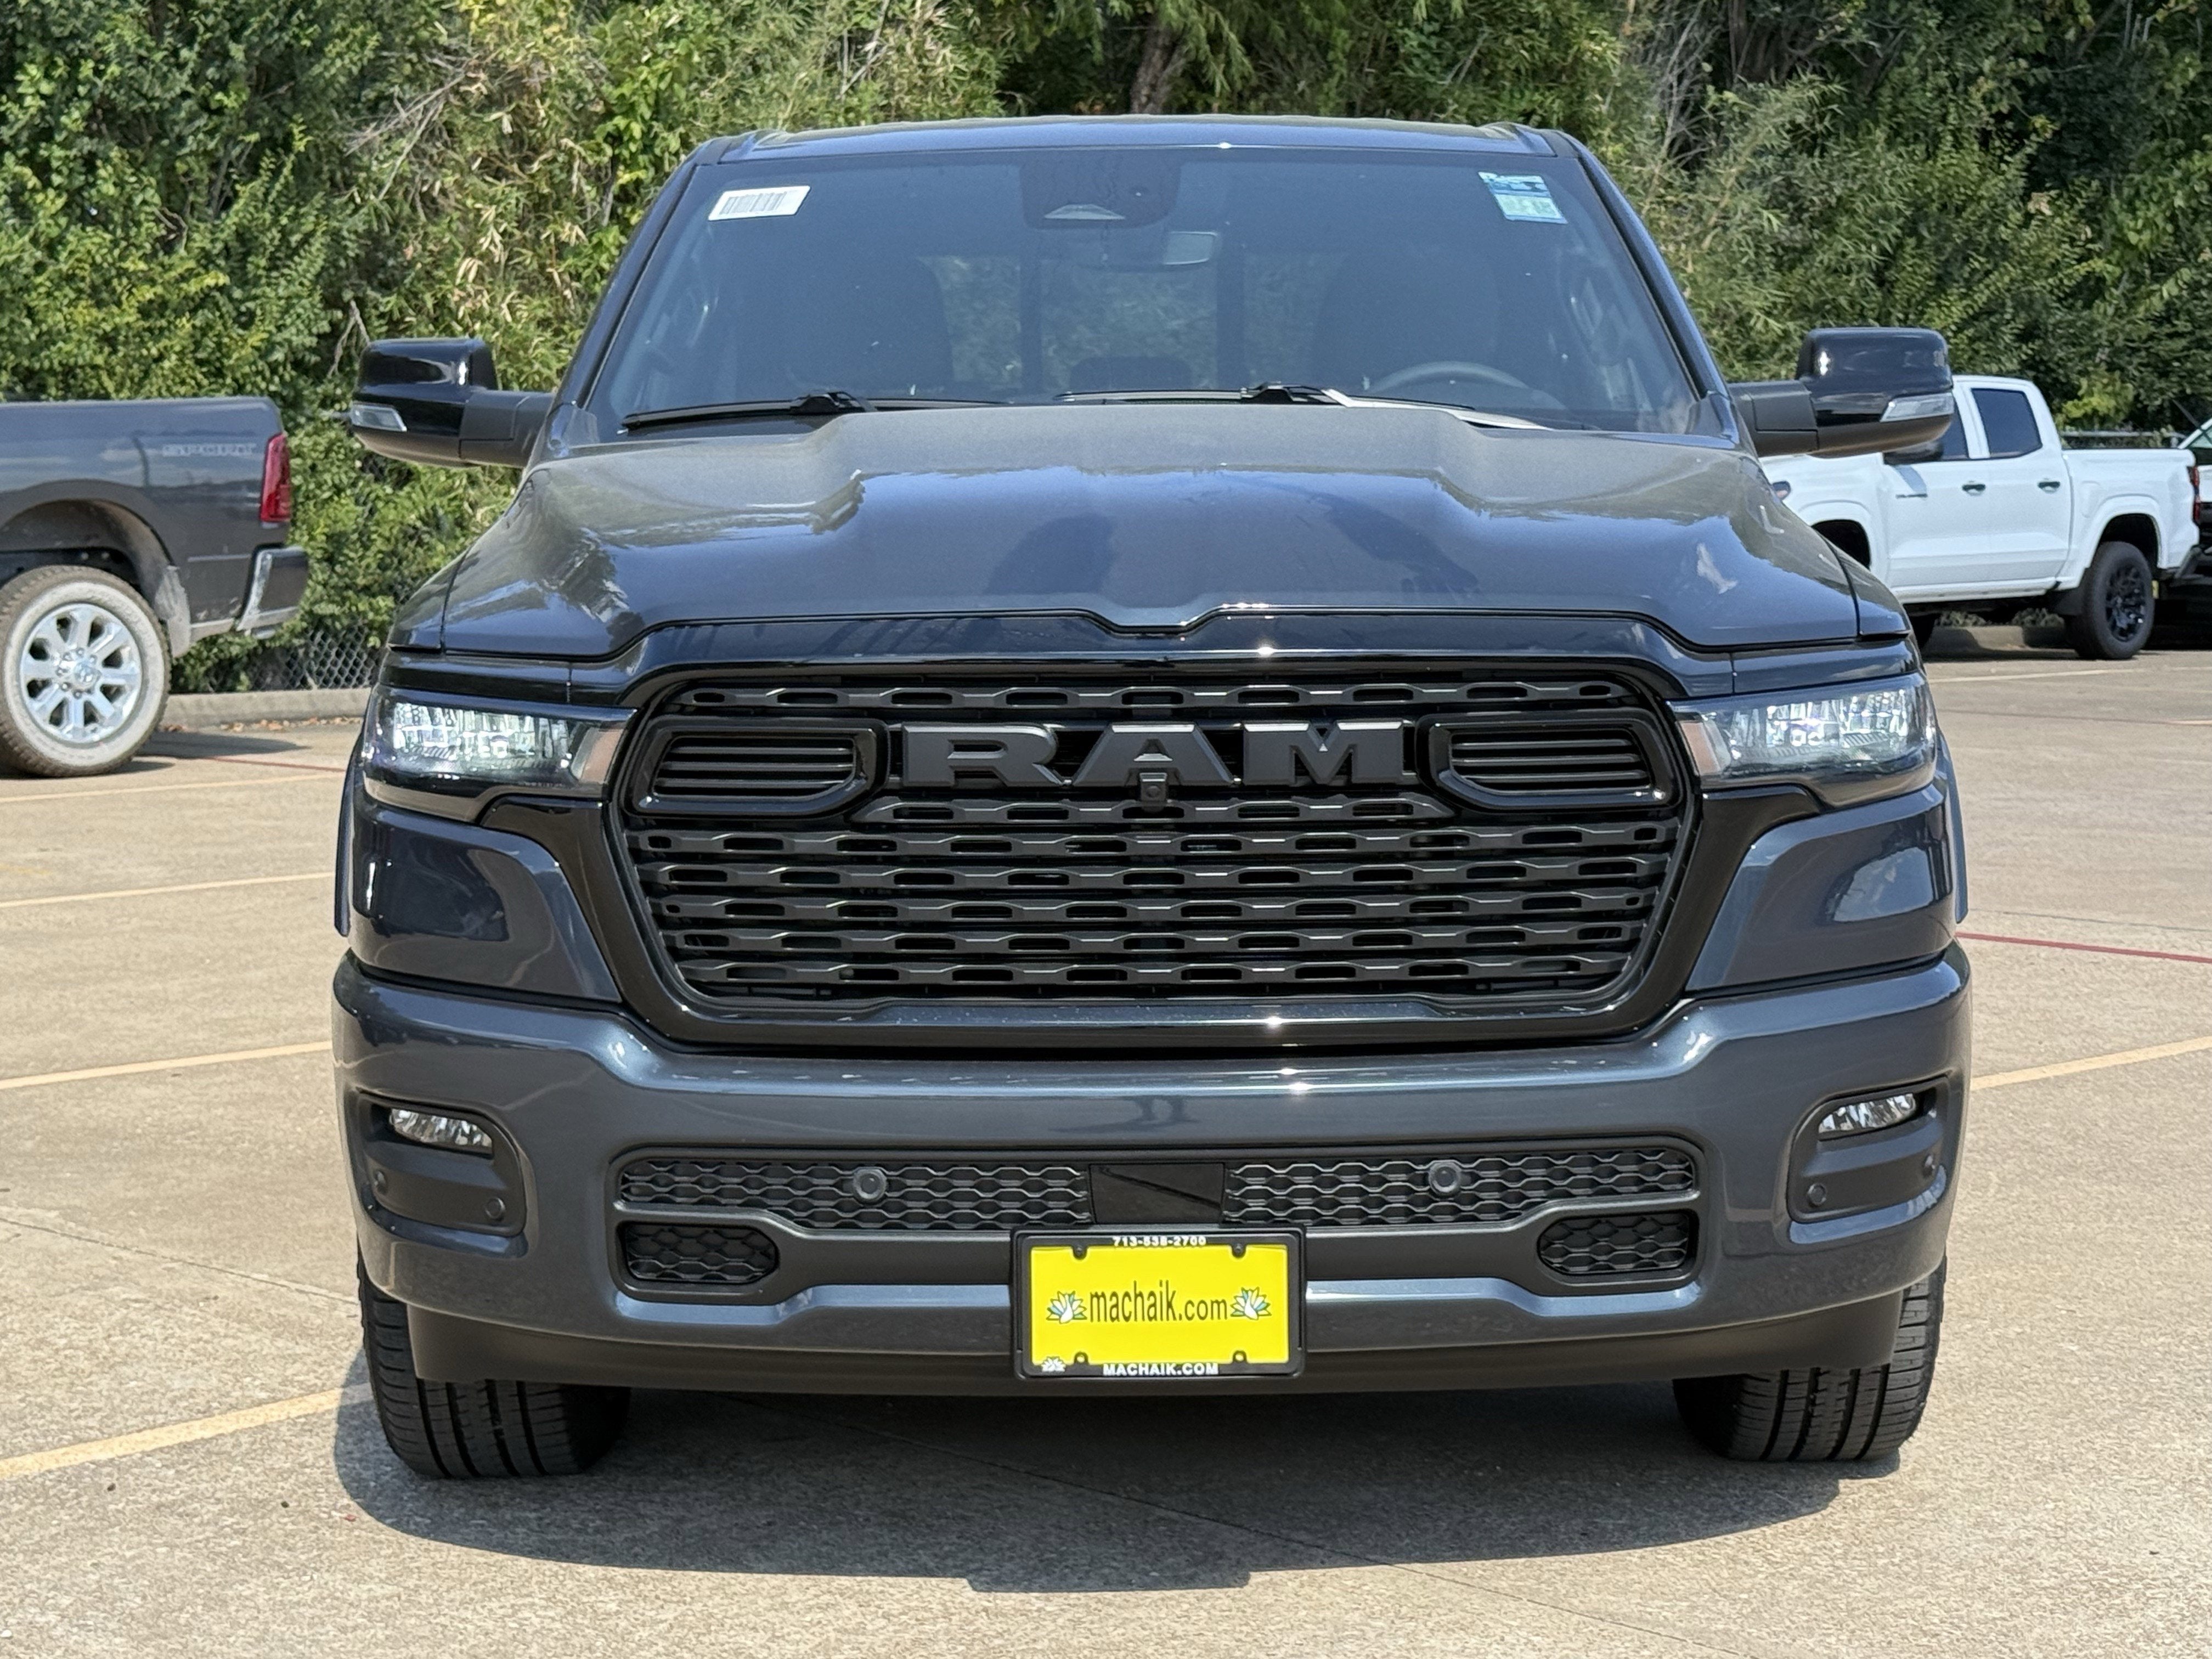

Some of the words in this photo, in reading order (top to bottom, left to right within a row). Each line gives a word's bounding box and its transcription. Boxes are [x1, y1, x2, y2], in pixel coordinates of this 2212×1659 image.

[901, 719, 1404, 788] RAM
[1090, 1279, 1228, 1323] machaik.com
[1102, 1363, 1219, 1376] MACHAIK.COM
